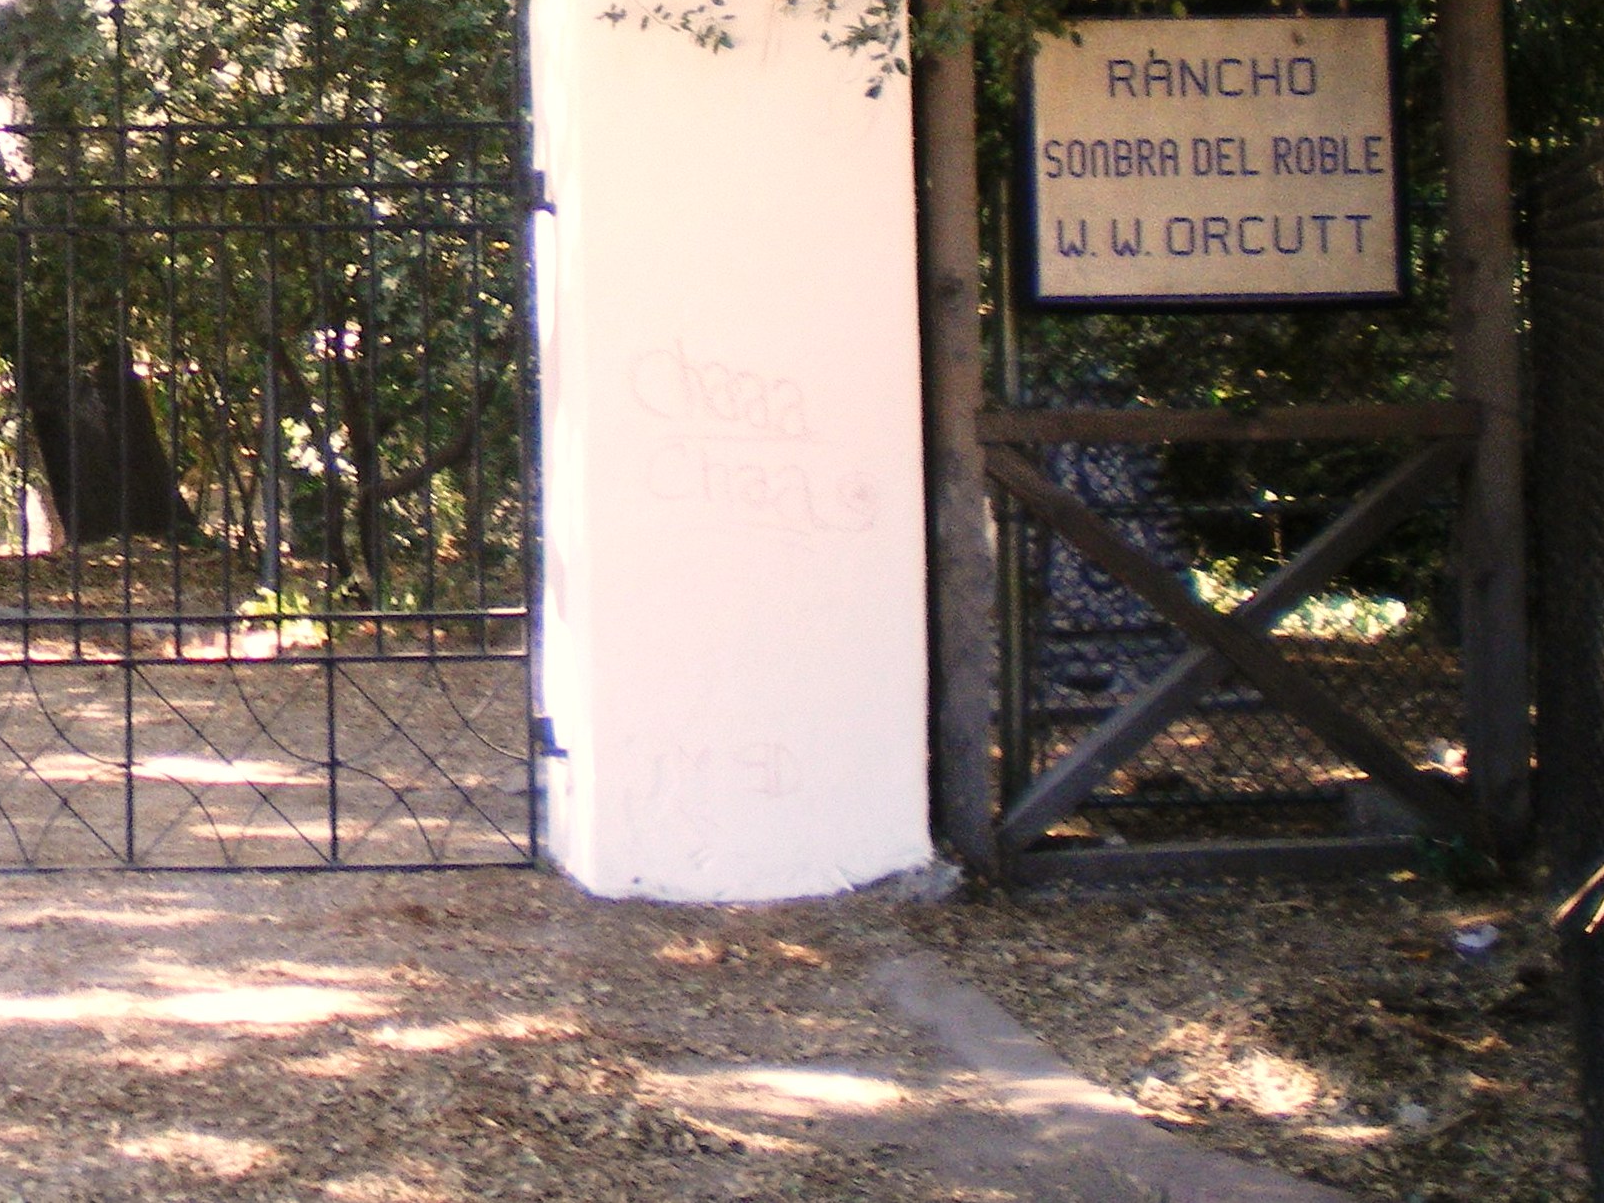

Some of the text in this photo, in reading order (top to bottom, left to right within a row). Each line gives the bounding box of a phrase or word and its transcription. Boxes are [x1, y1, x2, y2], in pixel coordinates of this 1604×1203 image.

[1107, 57, 1317, 97] RANCHO
[1192, 137, 1260, 177] DEL
[1272, 136, 1385, 176] ROBLE
[1165, 214, 1372, 256] ORCUTT
